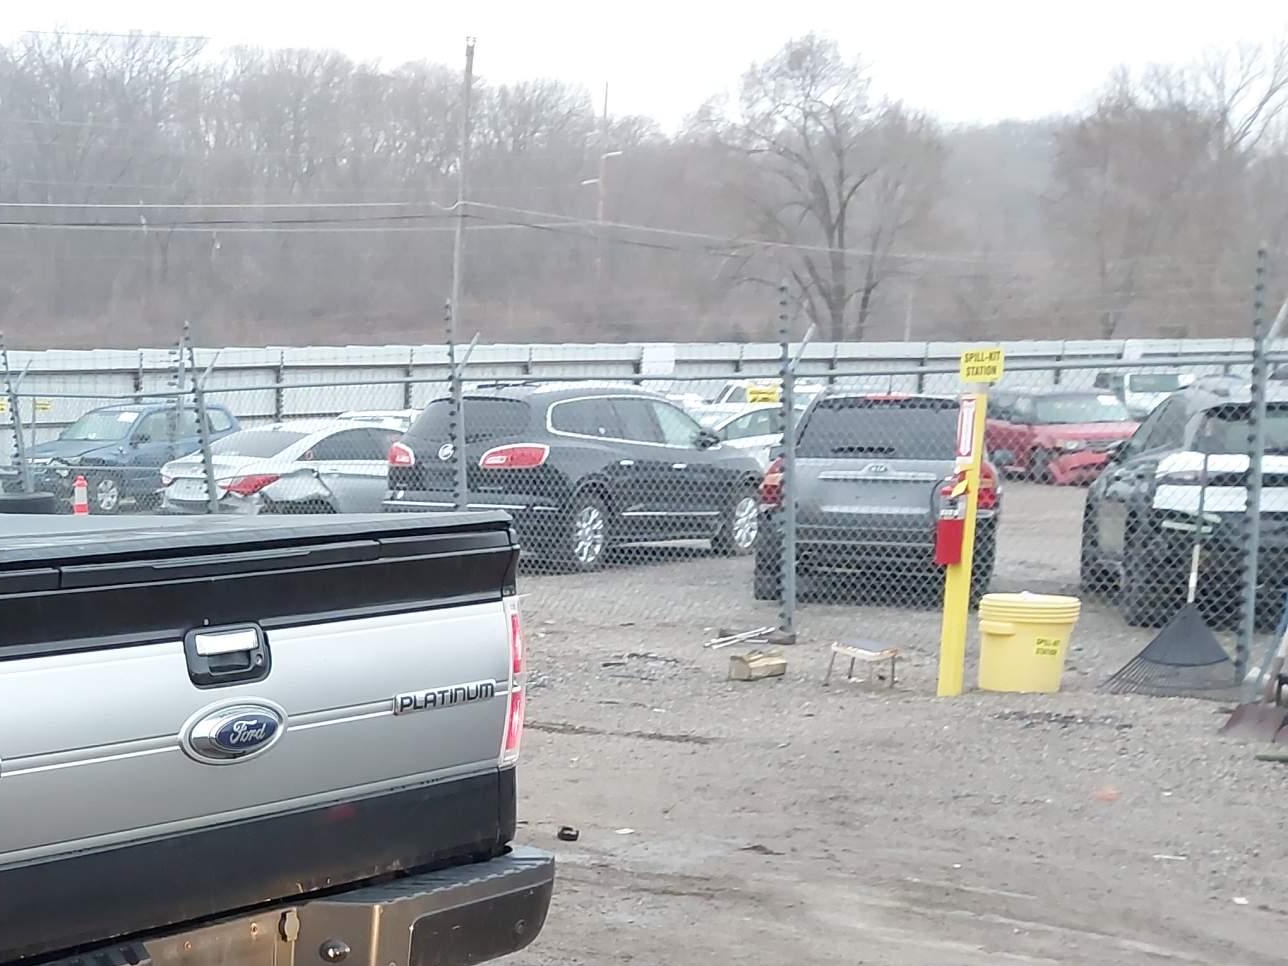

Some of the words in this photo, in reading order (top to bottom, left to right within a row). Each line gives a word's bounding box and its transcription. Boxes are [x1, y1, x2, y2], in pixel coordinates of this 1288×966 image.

[964, 350, 1001, 363] SPILL-KIT
[966, 365, 998, 377] STATION
[399, 682, 495, 712] PLATINUM
[230, 719, 266, 744] Ford
